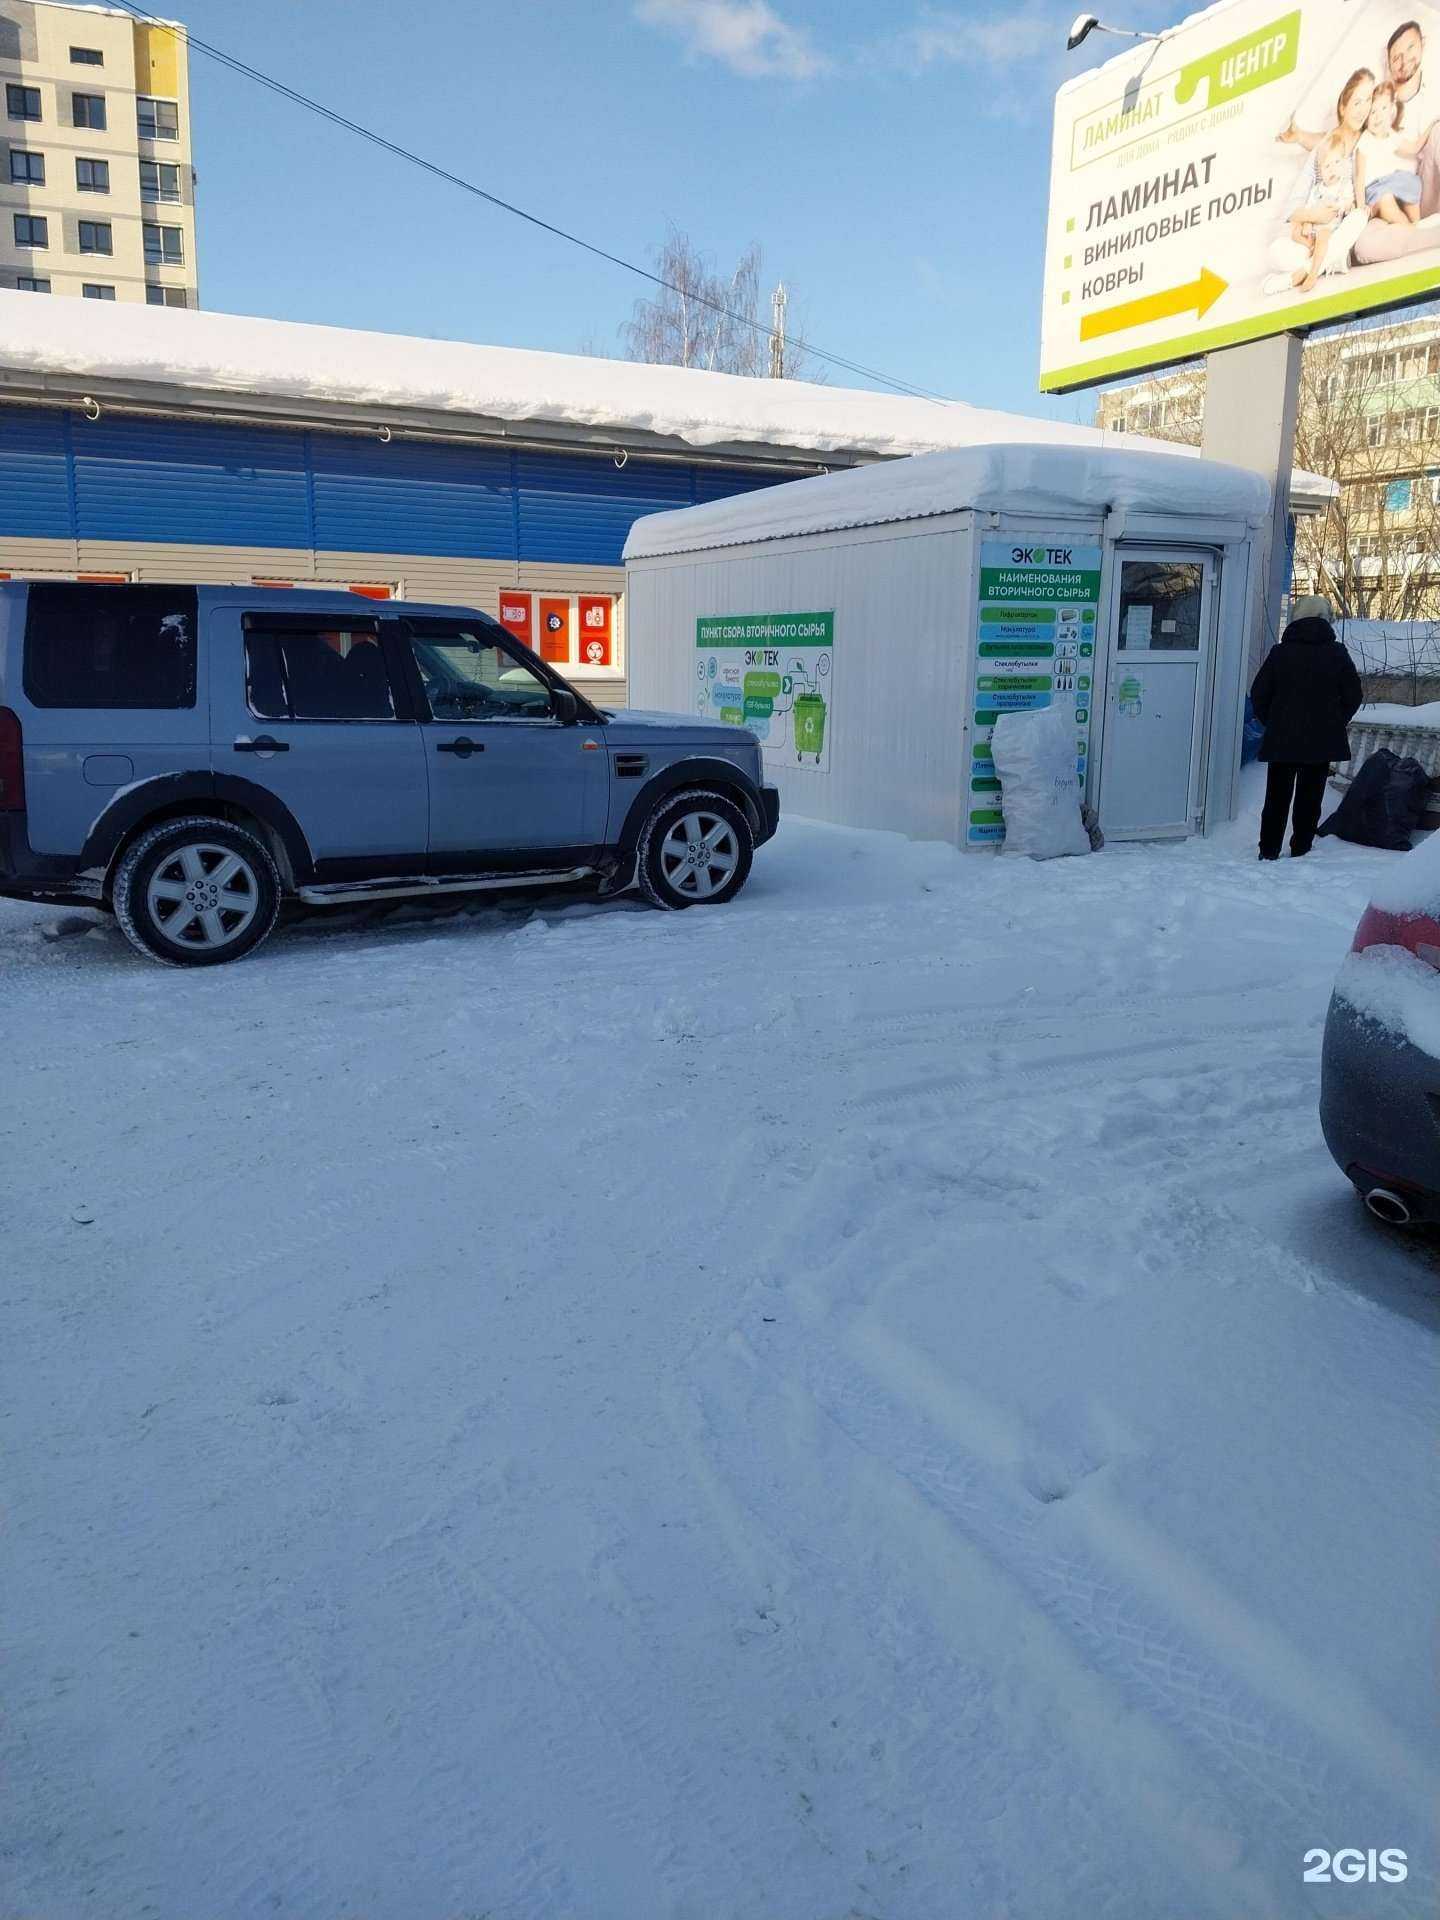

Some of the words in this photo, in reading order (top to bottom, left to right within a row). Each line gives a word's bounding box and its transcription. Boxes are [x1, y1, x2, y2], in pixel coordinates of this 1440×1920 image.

[1082, 91, 1164, 151] ЛАМИНАТ
[1219, 33, 1287, 88] ЦЕНТР
[1085, 154, 1217, 232] ЛАМИНАТ
[1083, 205, 1201, 266] ВИНИЛОВЫЕ
[1208, 178, 1273, 219] ПОЛЫ
[1081, 262, 1144, 301] КОВРЫ
[1011, 547, 1073, 565] ЭКОТЕК
[999, 573, 1082, 584] НАИМЕНОВАНИЯ
[988, 586, 1055, 597] ВТОРИЧНОГО
[1057, 587, 1091, 598] СЫРЬЯ
[701, 626, 722, 639] ПУНКТ
[722, 626, 745, 638] СБОРА
[746, 624, 797, 637] ВТОРИЧНОГО
[797, 622, 826, 636] СЫРЬЯ
[744, 650, 780, 666] ЭКОТЕК
